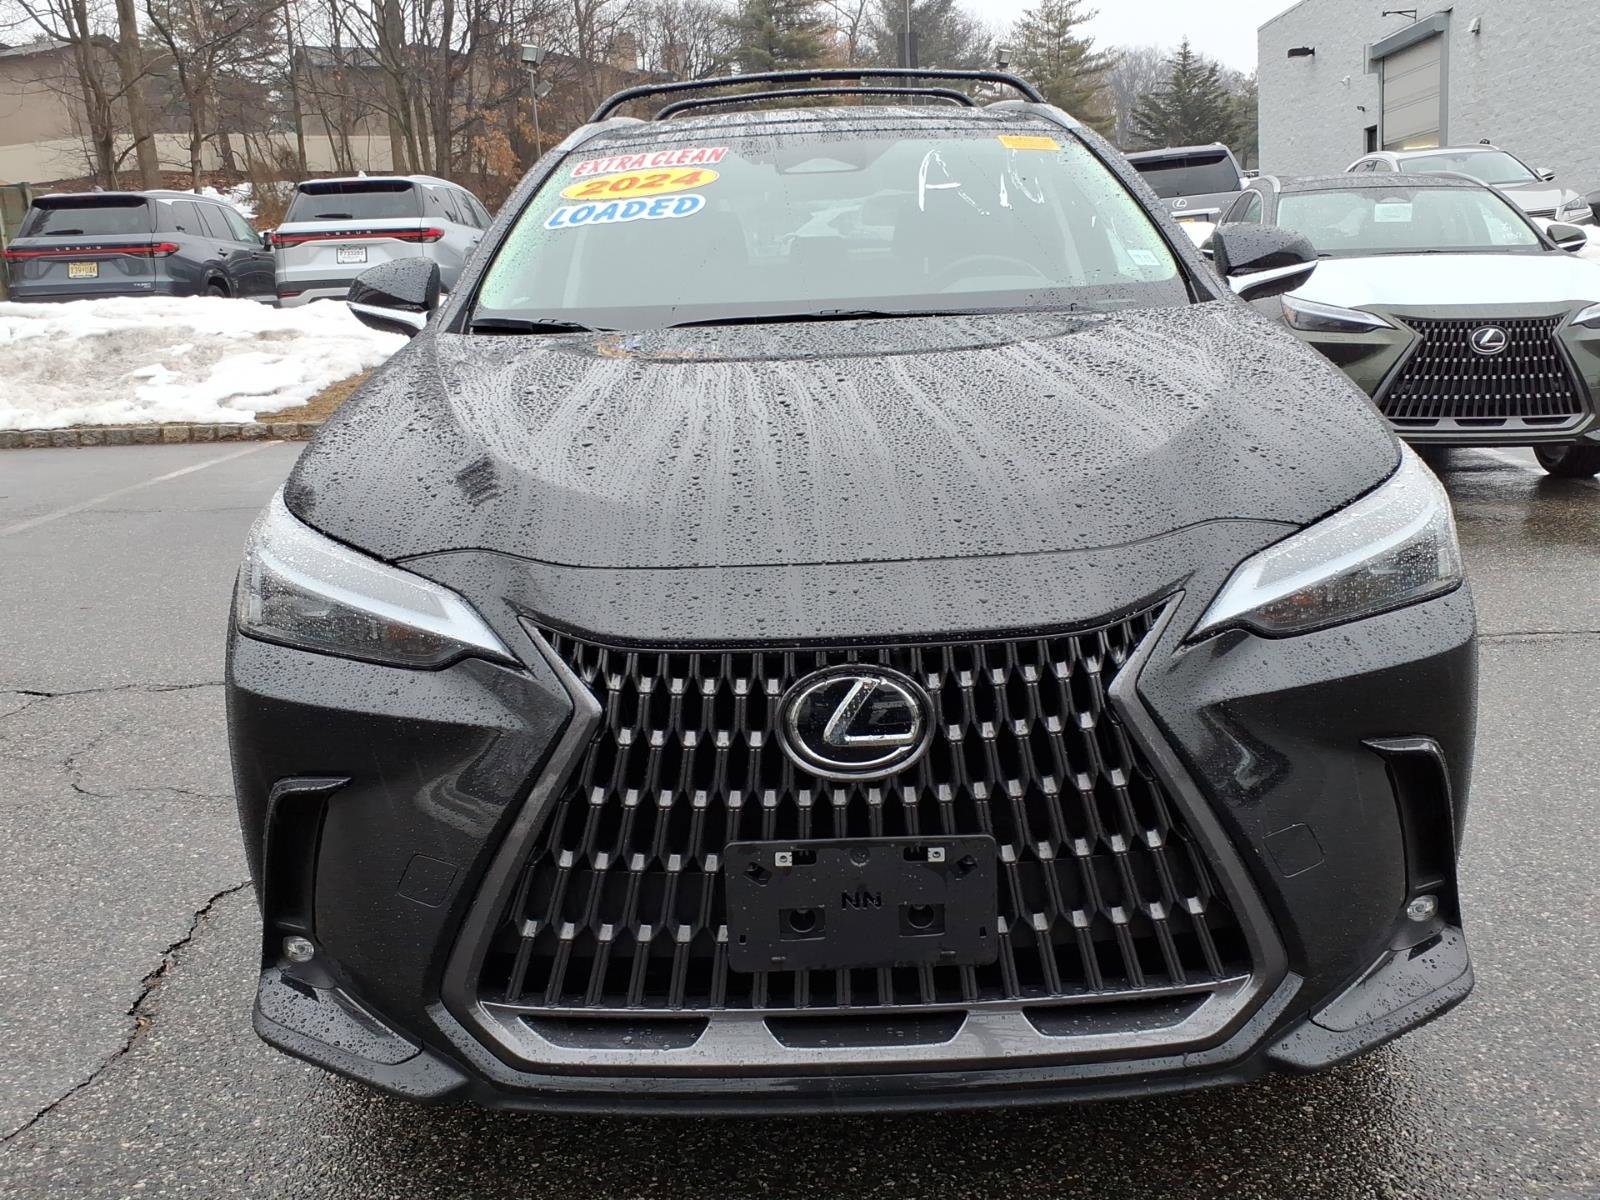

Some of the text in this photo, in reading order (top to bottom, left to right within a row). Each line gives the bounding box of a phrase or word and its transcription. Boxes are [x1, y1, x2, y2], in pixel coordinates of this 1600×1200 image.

[573, 148, 727, 176] EXTRA CLEAN
[576, 169, 704, 197] 2024
[548, 198, 700, 227] LOADED
